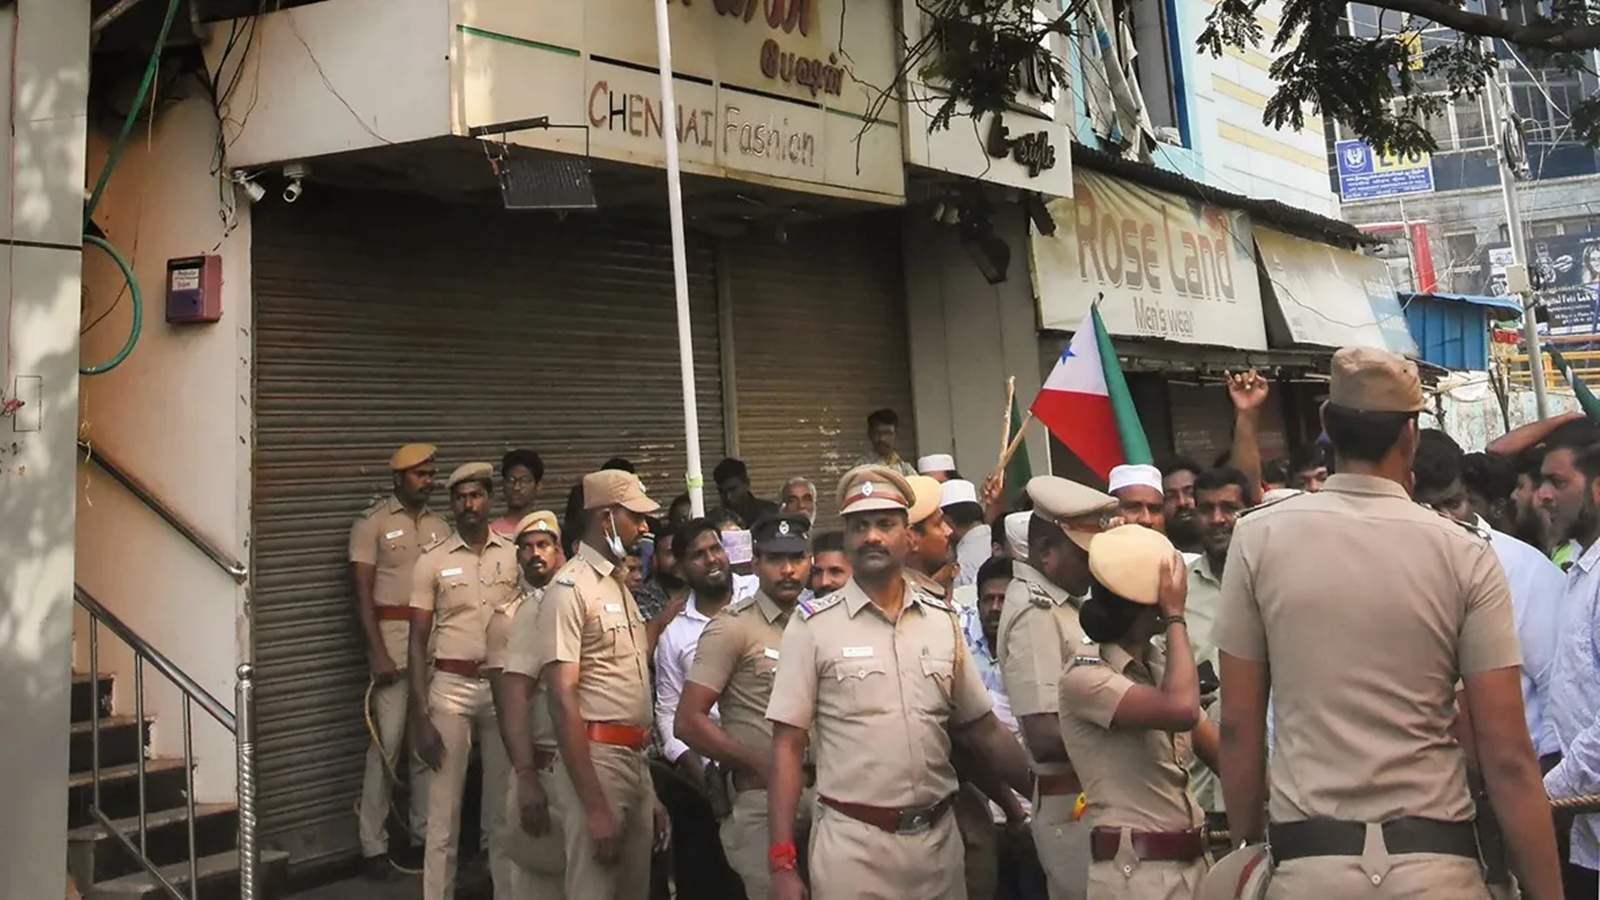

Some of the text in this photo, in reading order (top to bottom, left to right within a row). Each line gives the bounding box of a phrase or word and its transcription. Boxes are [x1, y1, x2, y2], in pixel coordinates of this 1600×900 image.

[588, 80, 815, 167] CHENNAI Fashion
[1074, 182, 1236, 302] Rose Land
[1133, 297, 1167, 331] Men's
